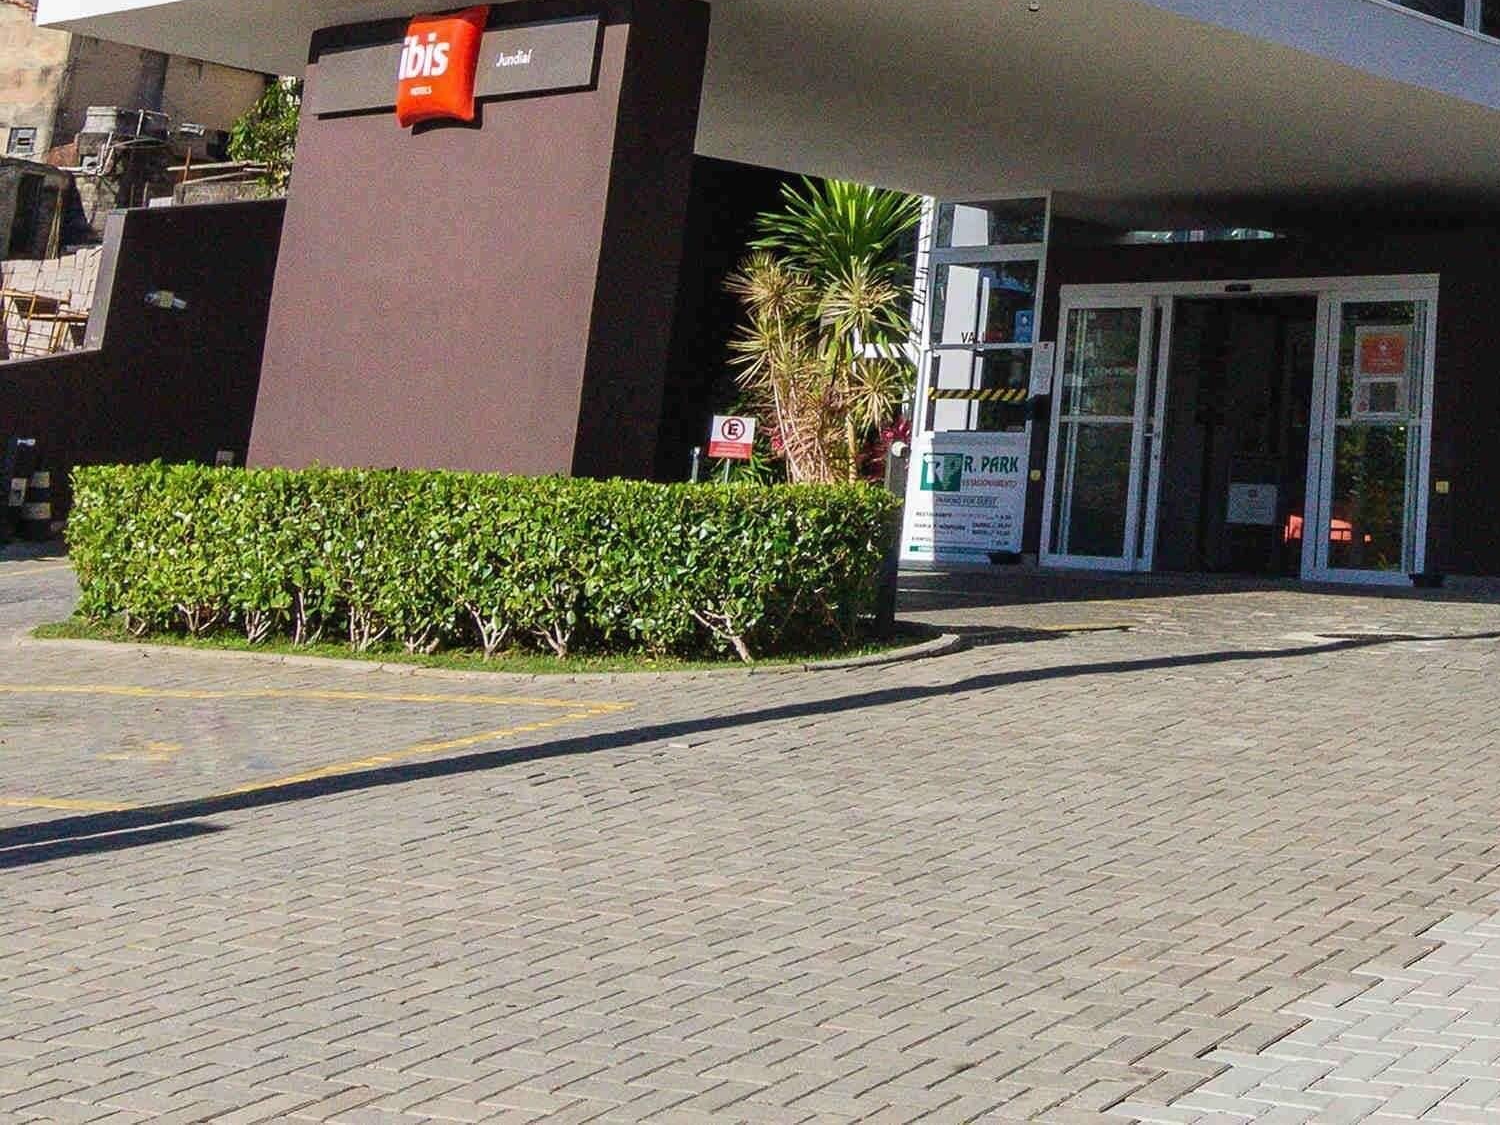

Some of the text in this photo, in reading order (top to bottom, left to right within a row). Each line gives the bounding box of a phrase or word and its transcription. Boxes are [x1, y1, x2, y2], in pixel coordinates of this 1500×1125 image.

[399, 32, 450, 81] ibis
[963, 455, 1019, 474] R. PARK
